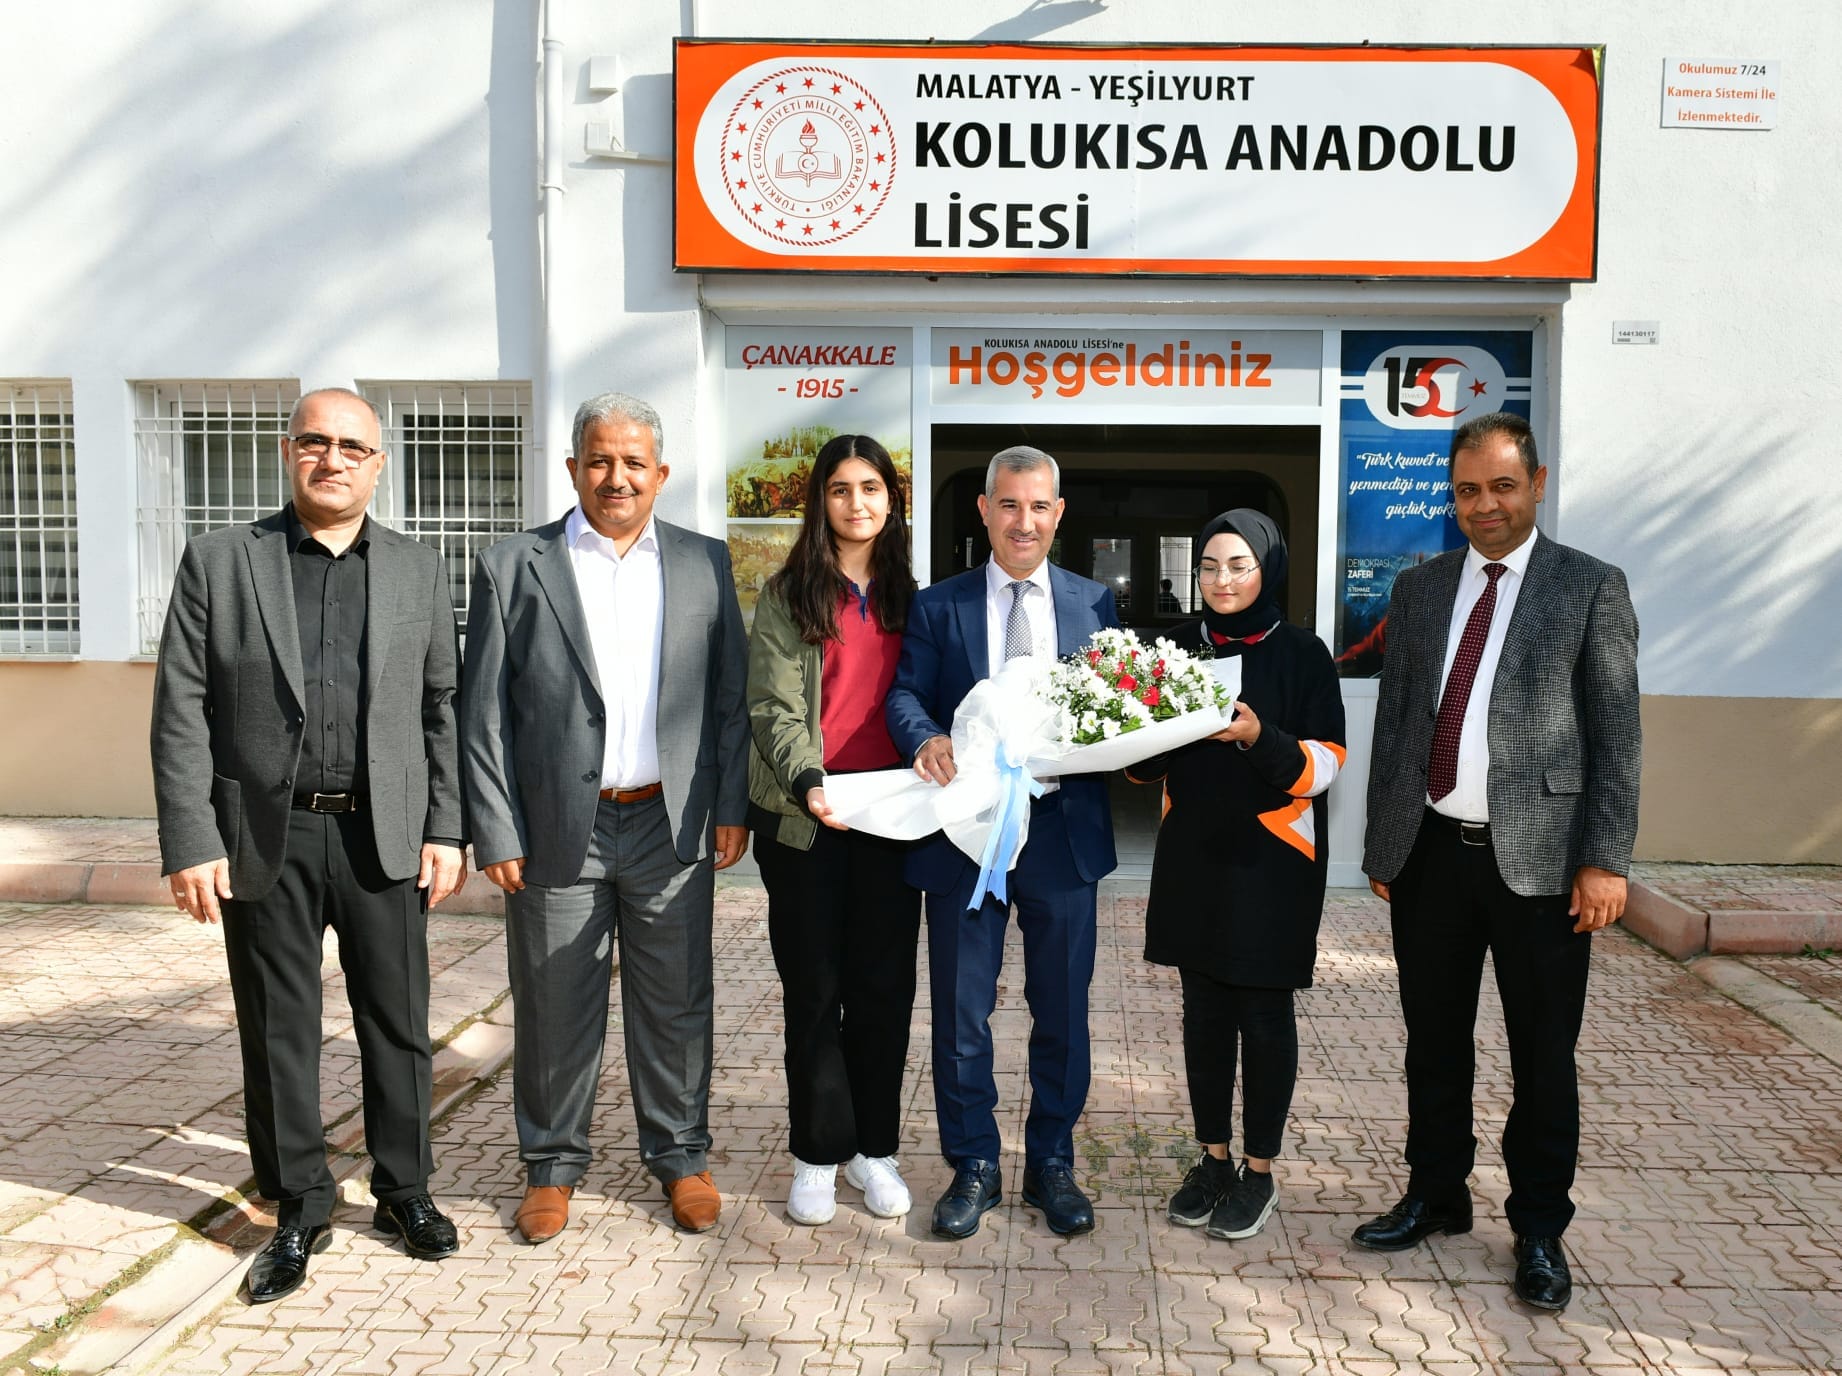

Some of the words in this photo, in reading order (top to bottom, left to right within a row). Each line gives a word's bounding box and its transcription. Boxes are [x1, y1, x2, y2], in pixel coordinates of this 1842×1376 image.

[1679, 63, 1737, 75] Okulumuz
[1740, 64, 1767, 77] 7/24
[916, 73, 1062, 101] MALATYA
[1088, 70, 1255, 108] YEŞİLYURT
[1667, 87, 1712, 99] Kamera
[1715, 87, 1759, 100] Sistemi
[805, 100, 838, 117] MİLLİ
[1677, 109, 1763, 124] İzlenmektedir.
[754, 100, 801, 169] CUMHURİYETİ
[838, 113, 864, 153] EĞİTİM
[916, 121, 1208, 170] KOLUKISA
[1226, 124, 1516, 172] ANADOLU
[757, 174, 796, 212] TÜRKİYE
[821, 158, 864, 211] BAKANLIĞI
[914, 191, 1090, 250] LİSESİ
[984, 339, 1030, 349] KOLUKISA
[1033, 339, 1078, 349] ANADOLU
[742, 344, 897, 370] ÇANAKKALE
[949, 340, 1272, 399] Hoşgeldiniz
[796, 378, 845, 399] 1915
[1348, 476, 1414, 495] yenmediği
[1415, 481, 1430, 491] ve
[1385, 500, 1428, 520] güçlük
[1347, 568, 1374, 579] ZAFERİ
